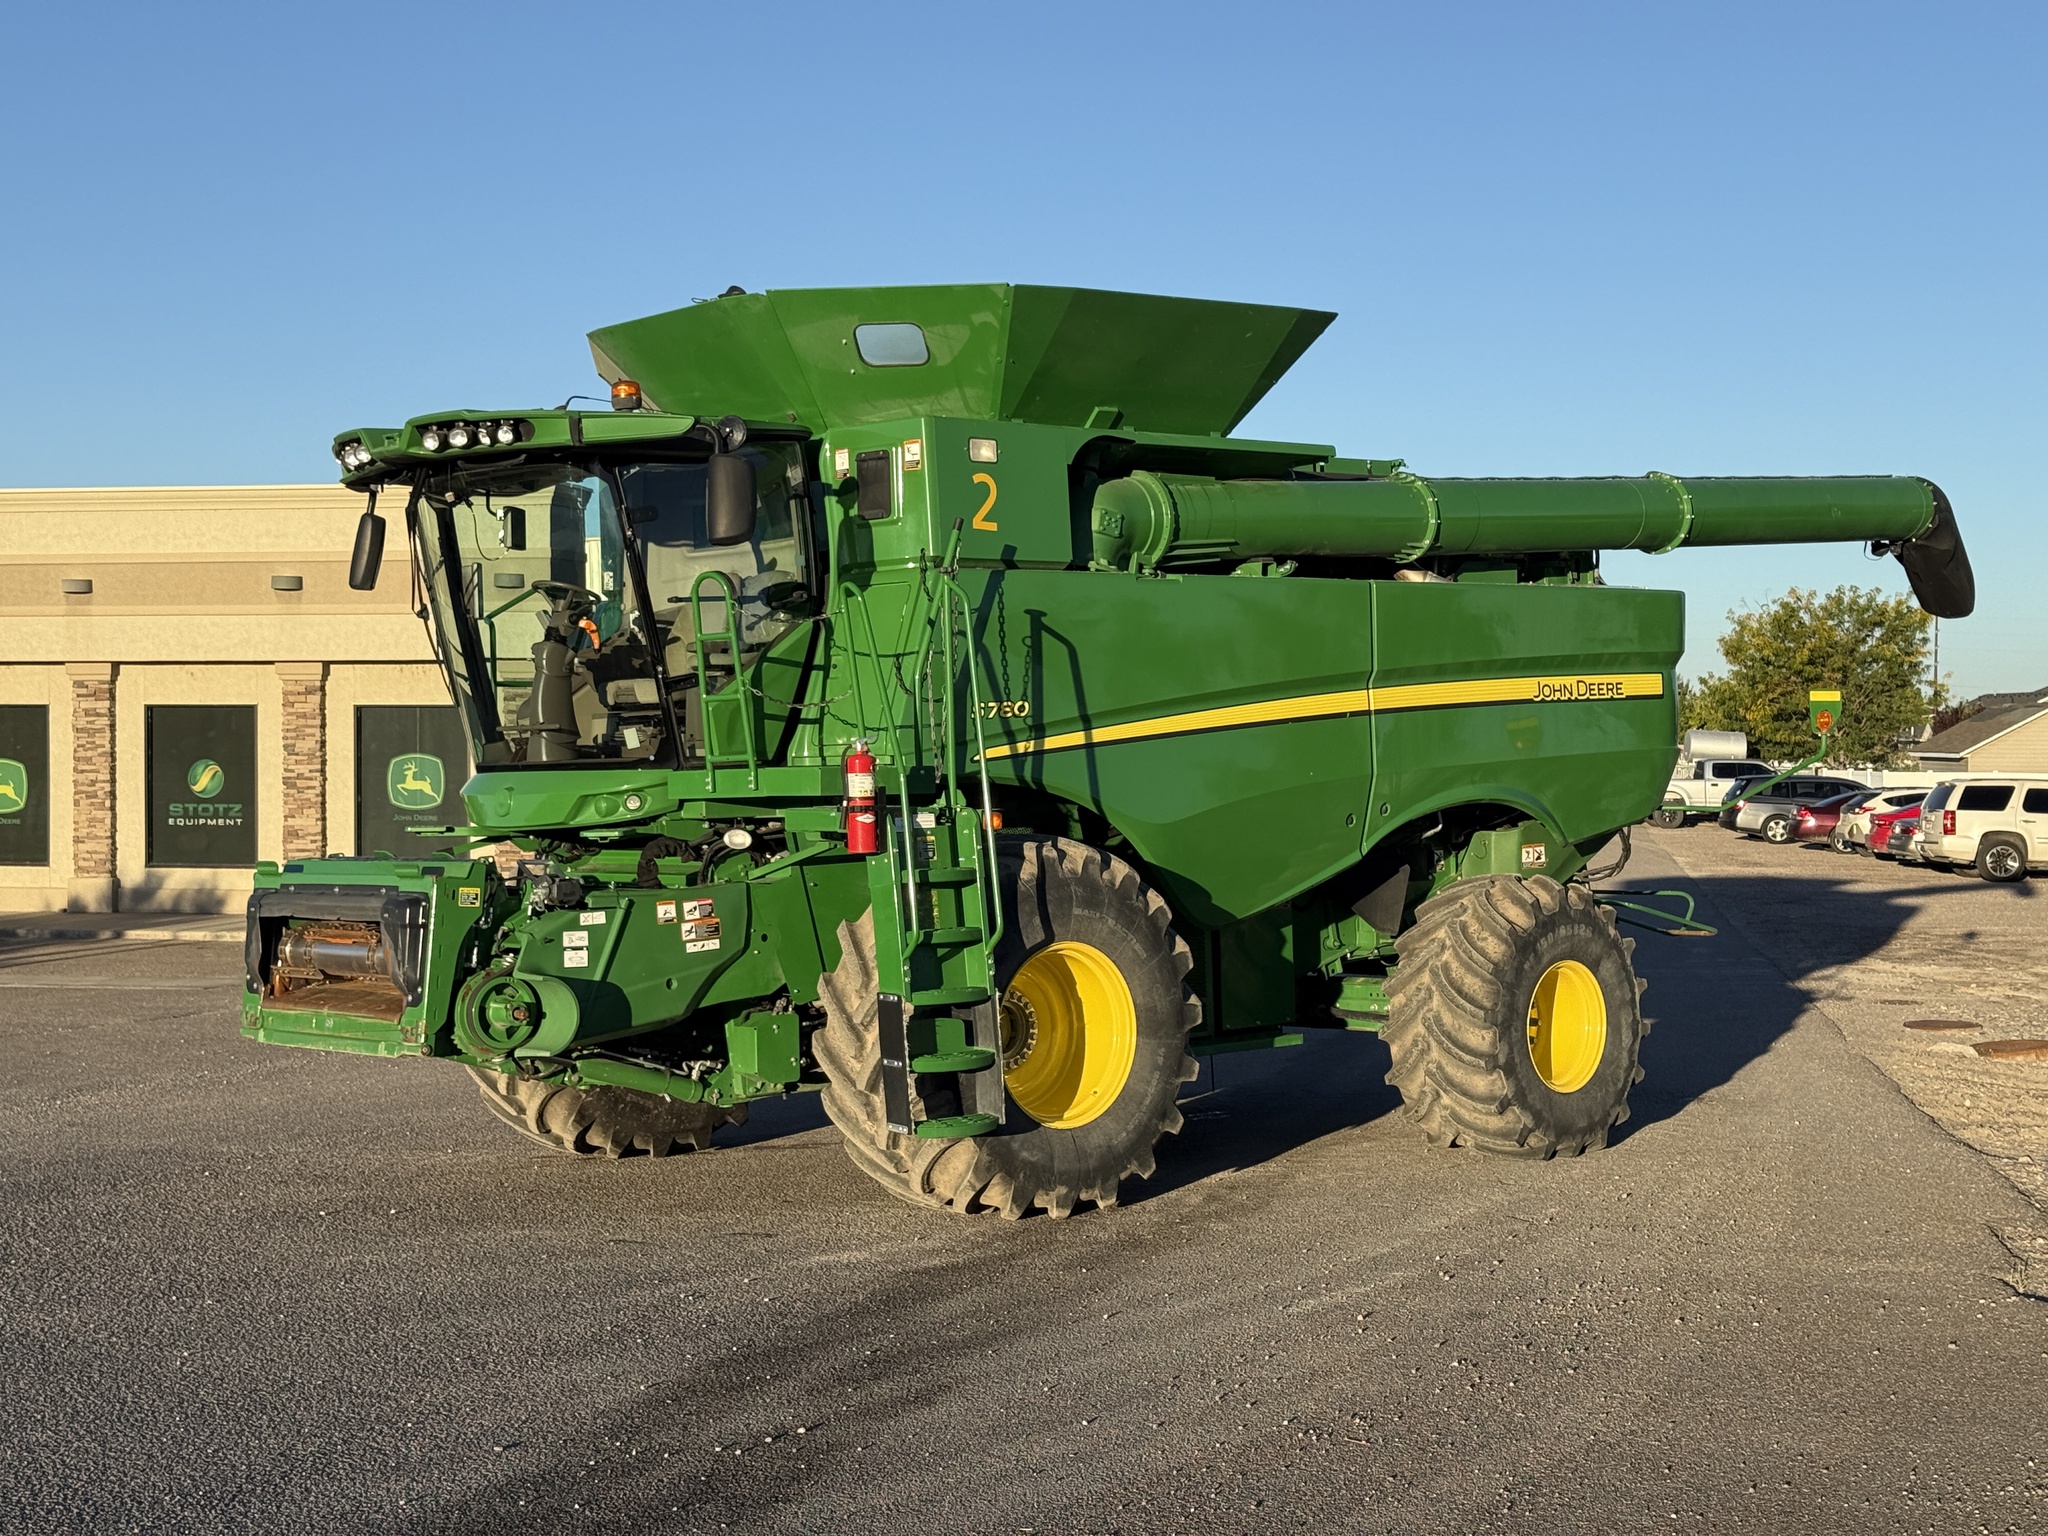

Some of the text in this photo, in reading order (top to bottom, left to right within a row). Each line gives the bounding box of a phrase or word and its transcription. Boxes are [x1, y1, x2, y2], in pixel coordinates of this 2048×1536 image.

[972, 472, 998, 532] 2
[1533, 679, 1625, 699] JOHN DEERE
[168, 803, 243, 817] STOTZ
[168, 818, 243, 827] EQUIPMENT
